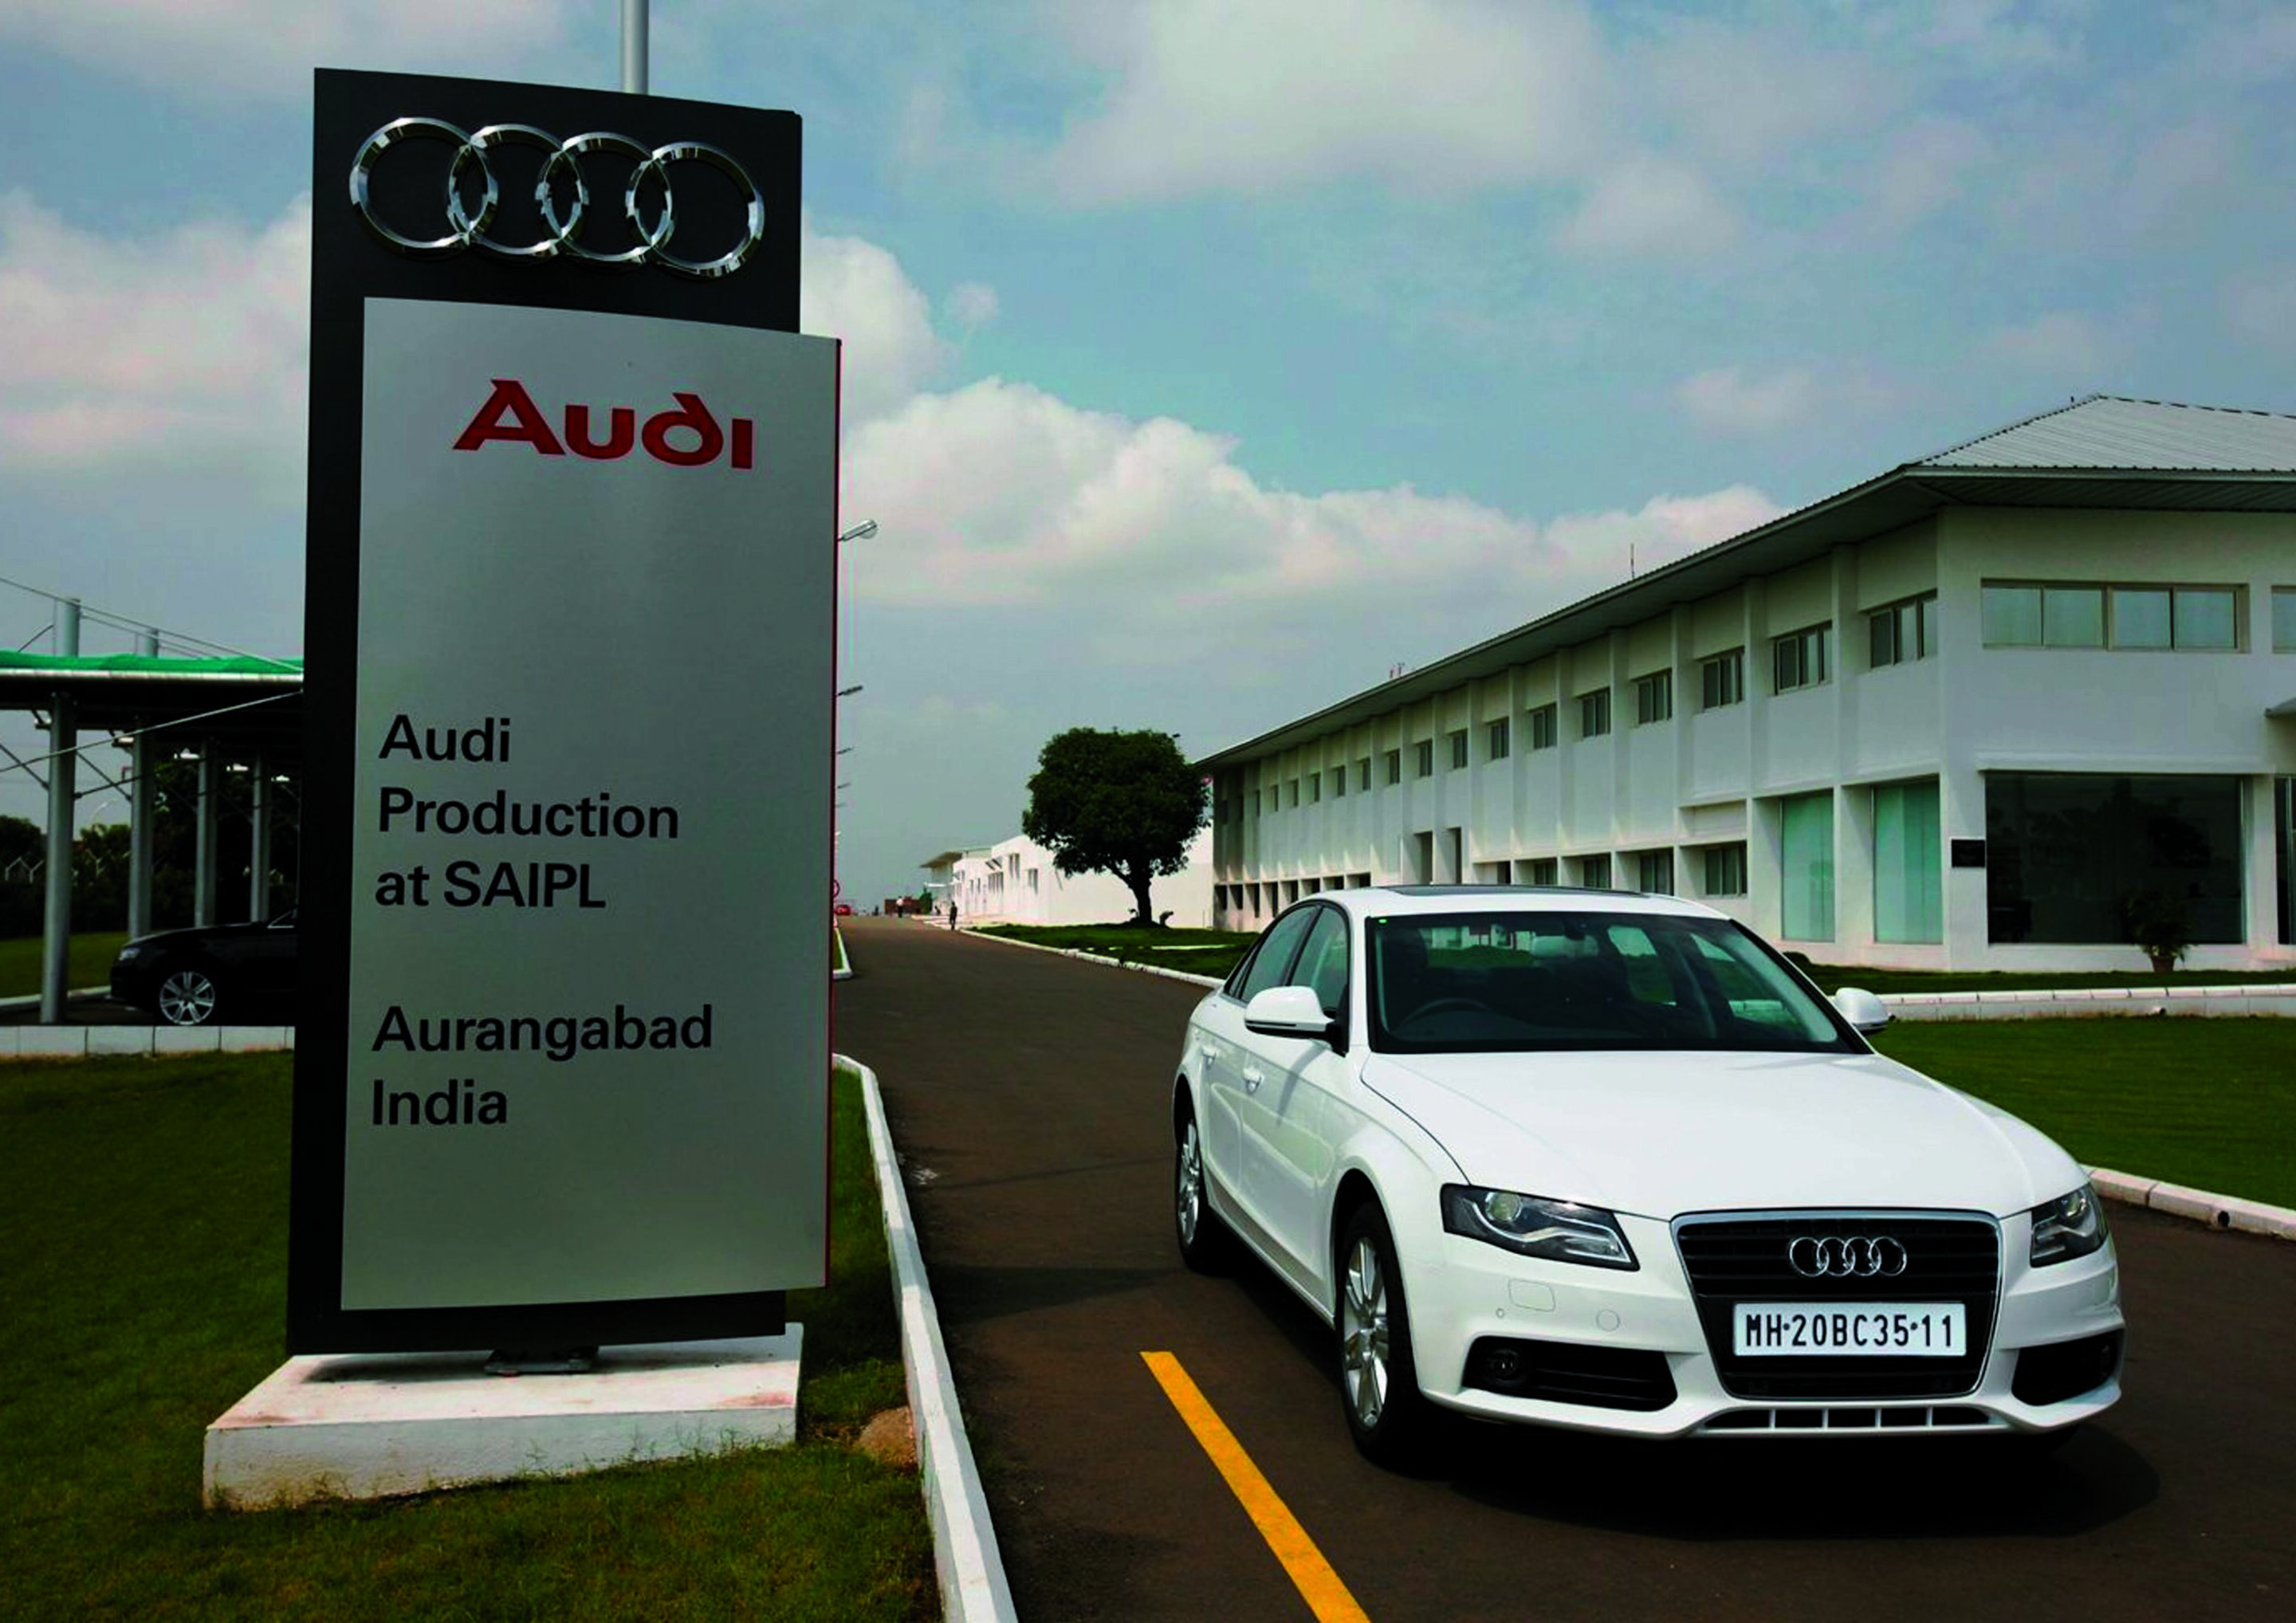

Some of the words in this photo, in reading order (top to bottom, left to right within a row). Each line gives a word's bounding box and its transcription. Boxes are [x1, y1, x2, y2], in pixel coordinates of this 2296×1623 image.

[452, 379, 753, 470] Audi
[379, 714, 511, 762] Audi
[379, 787, 678, 839] Production
[375, 866, 430, 906] at
[443, 861, 606, 908] SAIPL
[372, 1004, 713, 1062] Aurangabad
[372, 1079, 508, 1125] India
